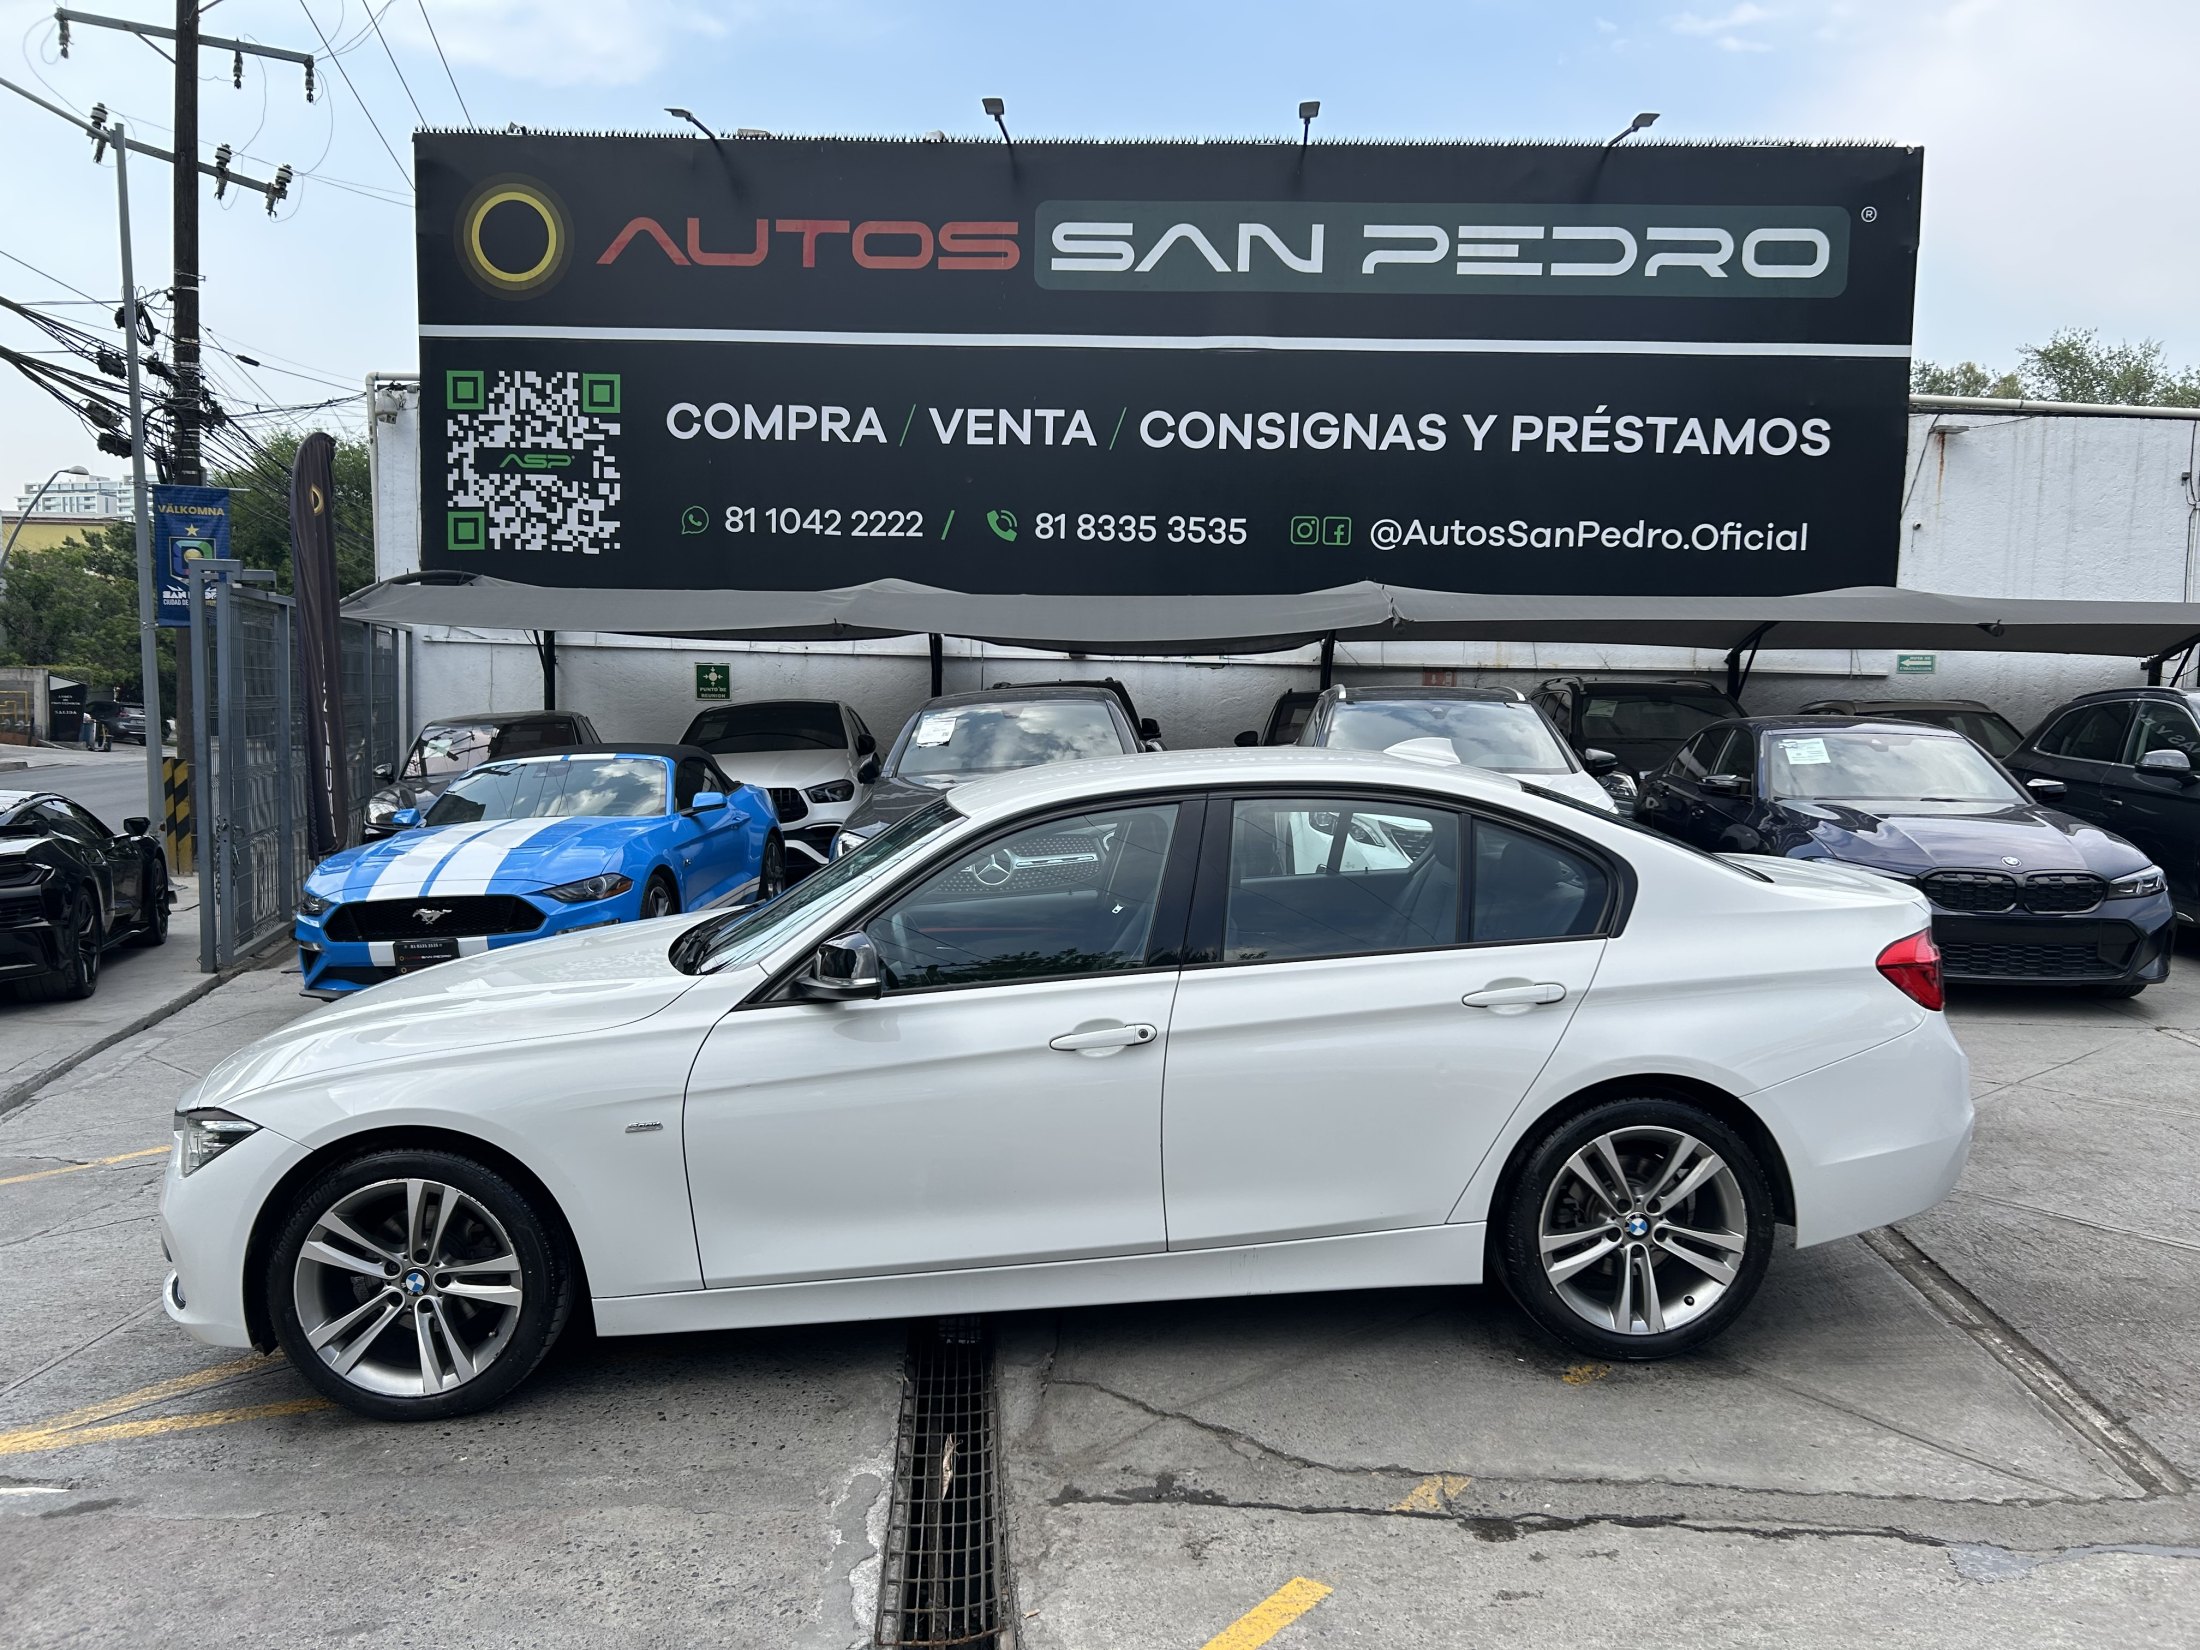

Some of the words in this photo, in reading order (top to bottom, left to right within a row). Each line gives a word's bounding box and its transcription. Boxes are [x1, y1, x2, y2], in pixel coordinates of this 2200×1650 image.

[597, 217, 1020, 270] AUTOS
[1051, 222, 1325, 274] SAN
[1362, 224, 1831, 278] PEDRO
[666, 402, 888, 444] COMPRA
[928, 407, 1098, 447] VENTA
[1139, 410, 1447, 452] CONSIGNAS
[1462, 414, 1498, 451] Y
[1511, 404, 1831, 457] PRÉSTAMOS
[500, 453, 572, 469] ASP
[158, 503, 225, 516] VÄLKOMNA
[724, 506, 756, 534] 81
[764, 507, 842, 537] 1042
[850, 510, 924, 538] 2222
[1034, 512, 1066, 540] 81
[1076, 513, 1157, 543] 8335
[1167, 515, 1247, 545] 3535
[1370, 518, 1808, 551] @AutosSanPedro.Oficial
